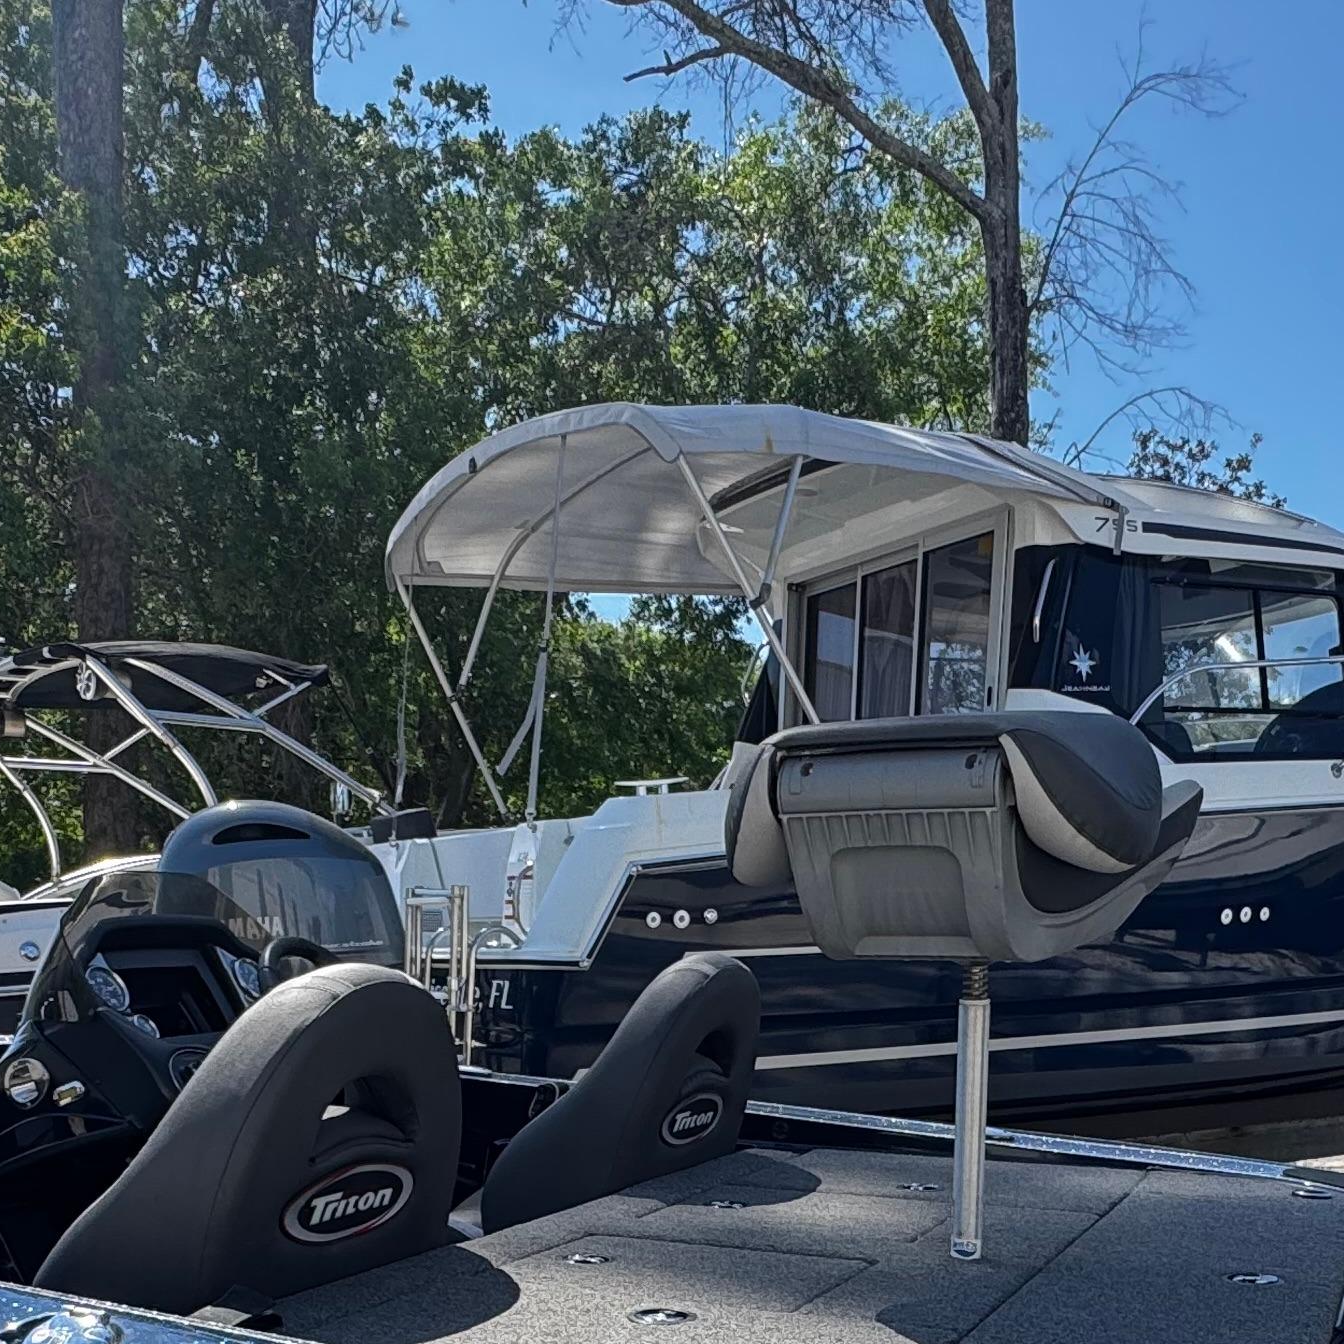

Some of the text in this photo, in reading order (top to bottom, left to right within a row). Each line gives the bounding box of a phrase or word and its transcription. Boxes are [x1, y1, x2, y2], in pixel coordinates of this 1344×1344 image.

[1061, 684, 1111, 692] JEANNEAU
[489, 980, 513, 1010] FL
[673, 1111, 714, 1132] Triton
[309, 1187, 394, 1226] Triton
